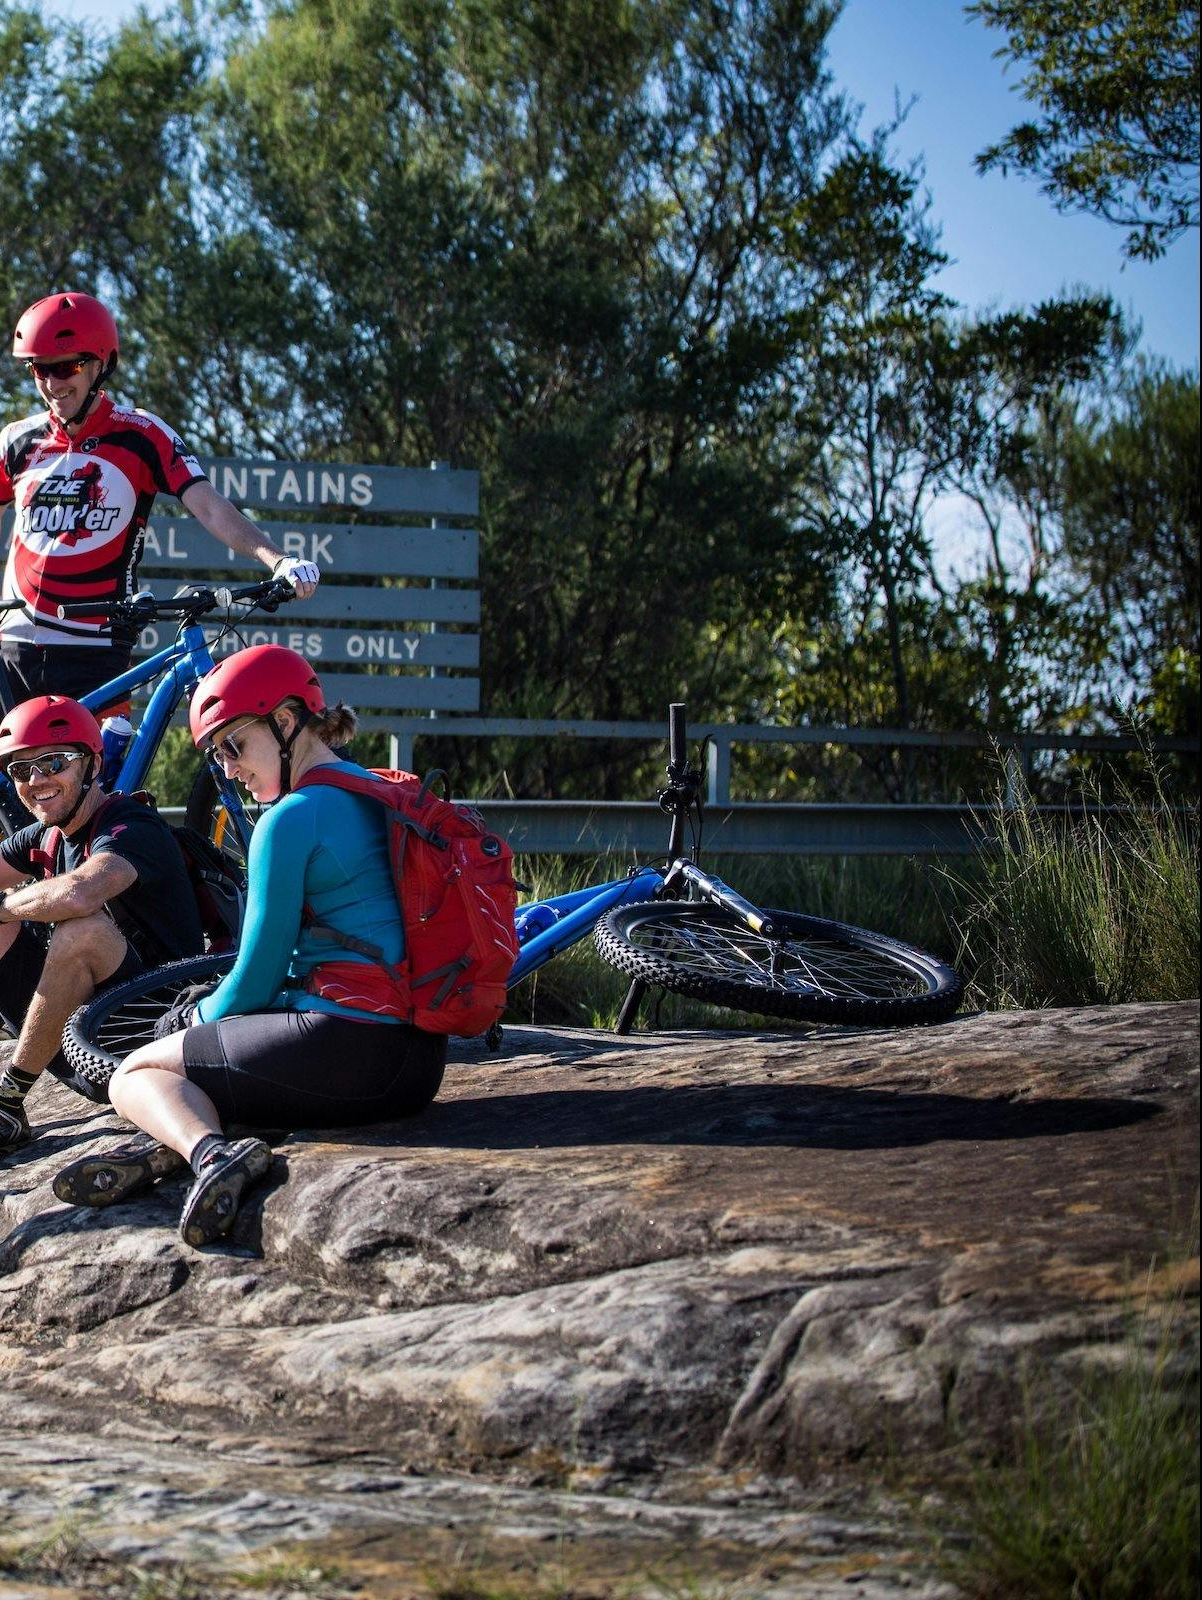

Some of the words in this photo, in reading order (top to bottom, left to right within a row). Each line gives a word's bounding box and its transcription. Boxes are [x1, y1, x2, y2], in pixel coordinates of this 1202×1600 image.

[39, 479, 86, 496] THE
[209, 465, 374, 506] NTAINS
[204, 629, 323, 657] EHICES
[347, 635, 420, 660] ONLY
